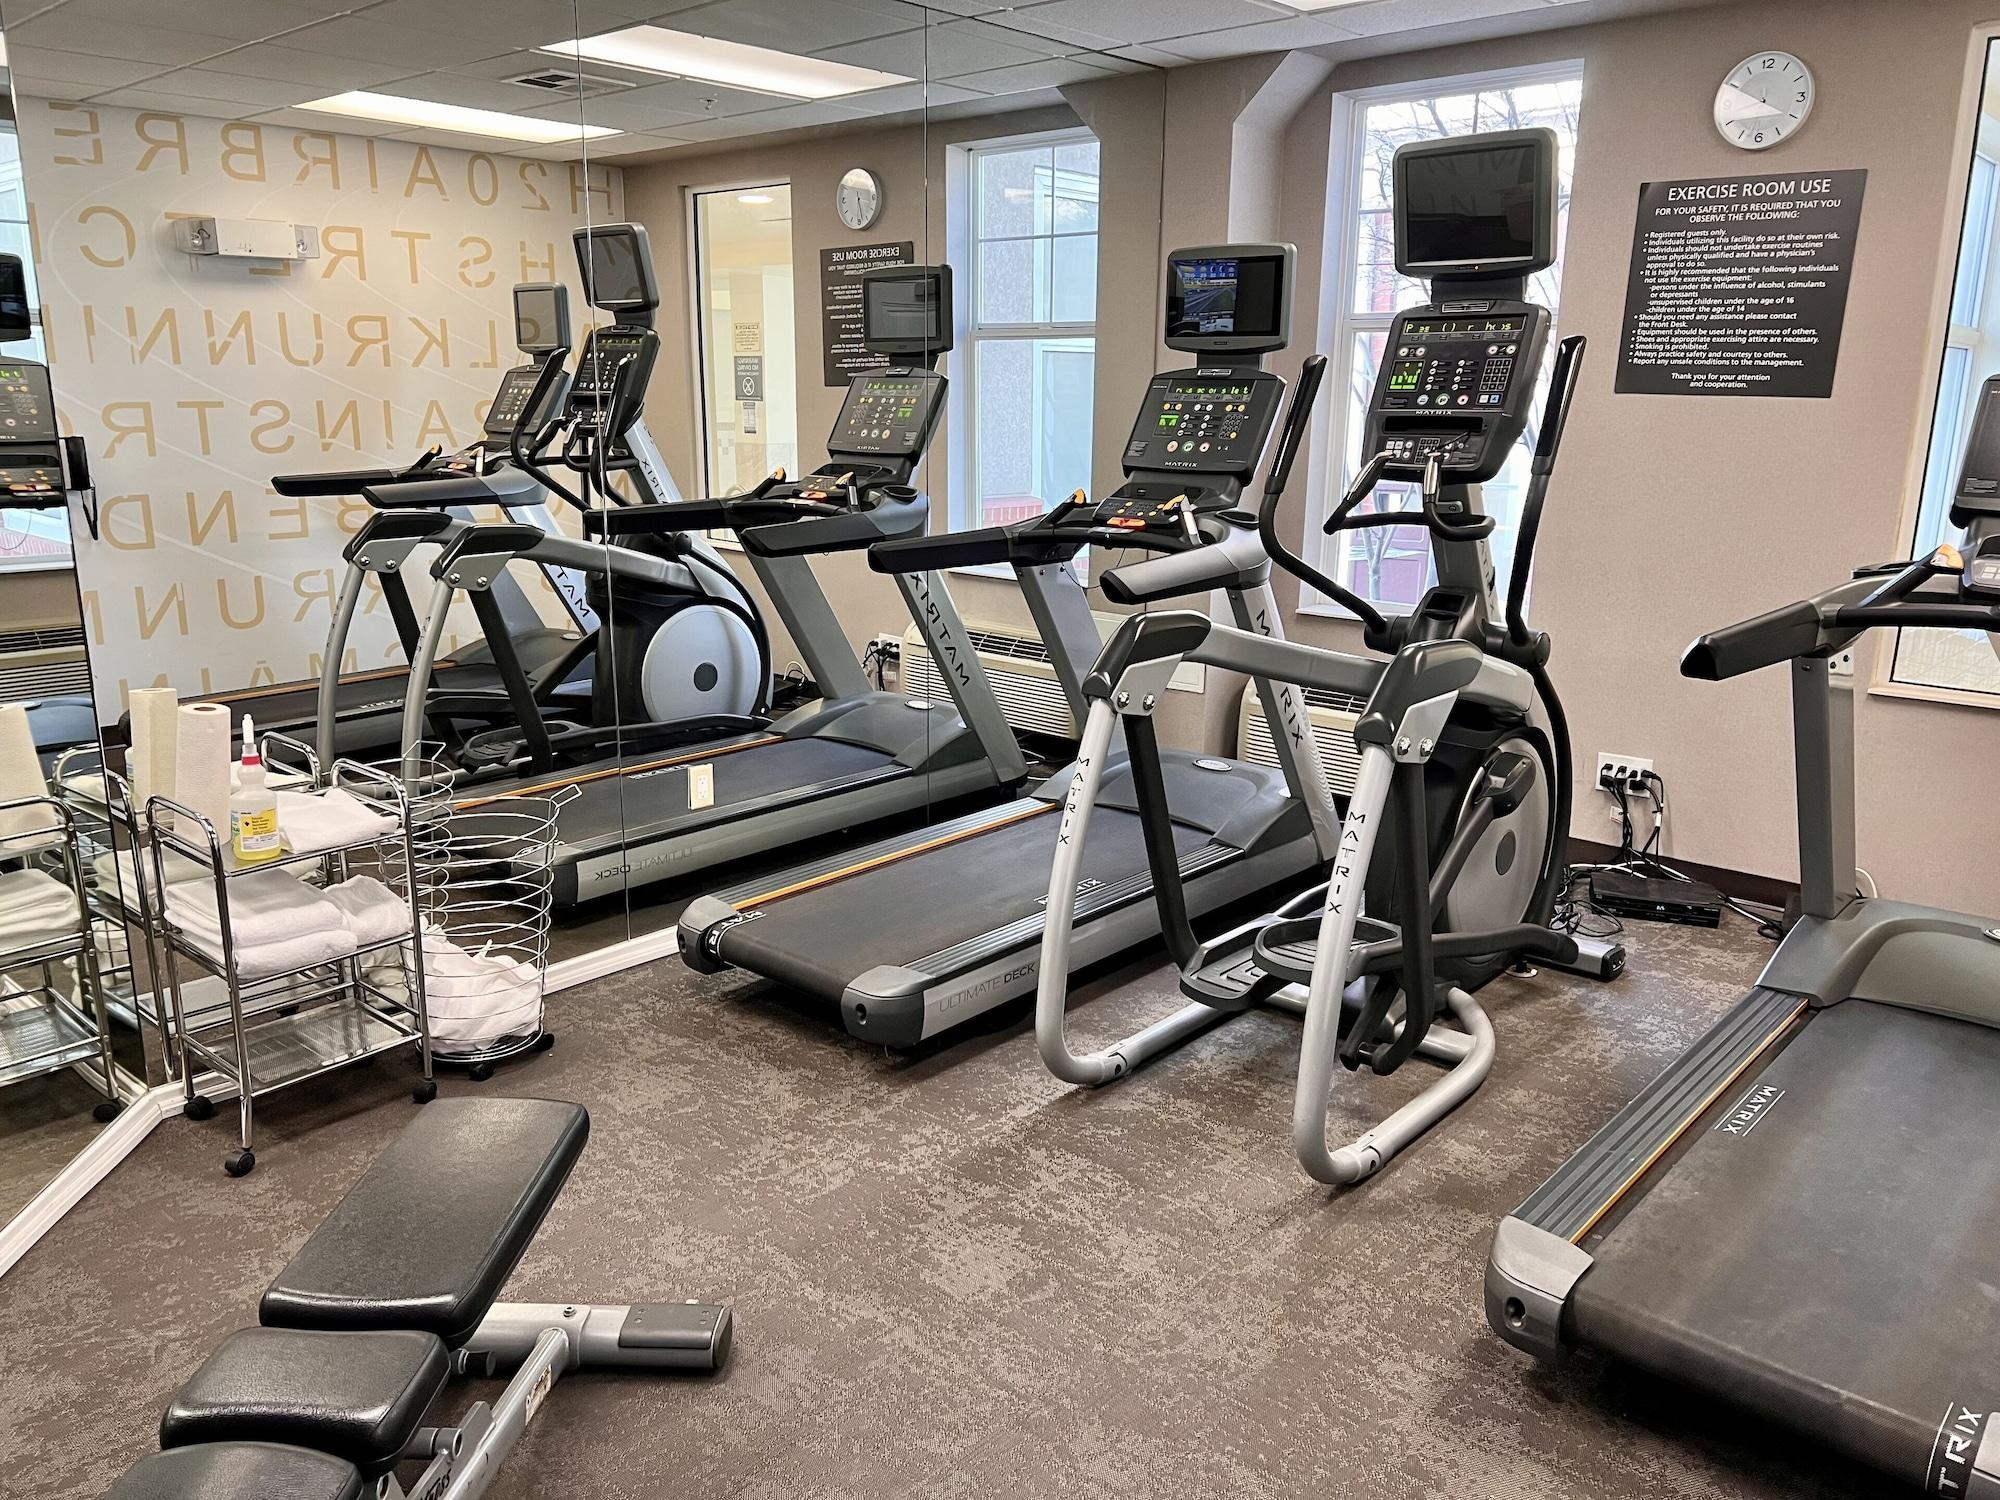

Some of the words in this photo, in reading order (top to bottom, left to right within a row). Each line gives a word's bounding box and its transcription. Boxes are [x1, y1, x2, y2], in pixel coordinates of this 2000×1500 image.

[1762, 58, 1775, 69] 12
[1796, 92, 1806, 102] 3
[1754, 132, 1764, 143] 6
[1668, 184, 1738, 201] EXERCISE
[1742, 180, 1795, 197] ROOM
[1800, 178, 1831, 194] USE
[1655, 207, 1671, 216] FOR
[1673, 206, 1696, 215] YOUR
[1731, 204, 1740, 212] IT
[1740, 203, 1748, 212] IS
[1749, 201, 1793, 211] REQUIRED
[1795, 200, 1819, 209] THAT
[1820, 199, 1841, 207] YOU
[1689, 213, 1726, 223] OBSERVE
[1727, 212, 1744, 221] THE
[1745, 210, 1800, 220] FOLLOWING:
[1648, 237, 1685, 246] Individuals
[1686, 236, 1715, 245] utilizing
[1730, 235, 1755, 244] facility
[1649, 230, 1686, 240] Registered
[1686, 230, 1709, 238] guests
[1647, 245, 1684, 253] Individuals
[1684, 244, 1709, 252] should
[1723, 242, 1761, 251] undertake
[1668, 252, 1702, 262] physically
[1702, 251, 1734, 260] qualified
[1646, 260, 1676, 270] approval
[1657, 268, 1680, 277] highly
[1680, 266, 1730, 275] recommended
[1761, 265, 1797, 274] following
[1798, 264, 1839, 272] individuals
[1787, 280, 1826, 288] stimulants
[1658, 291, 1698, 299] depressants
[1775, 296, 1785, 304] of
[1744, 312, 1768, 321] please
[1637, 328, 1673, 336] Equipment
[1670, 335, 1711, 344] appropriate
[1711, 335, 1747, 344] exercising
[1634, 342, 1664, 351] Smoking
[1633, 350, 1657, 358] Always
[1657, 350, 1685, 358] practice
[1685, 350, 1707, 359] safety
[1722, 351, 1753, 359] courtesy
[1059, 757, 1090, 845] MATRIX
[1328, 812, 1366, 914] MATRIX
[940, 977, 1001, 1012] ULTIMATE
[1004, 962, 1036, 984] DECK
[1722, 1085, 1778, 1134] MATRIX
